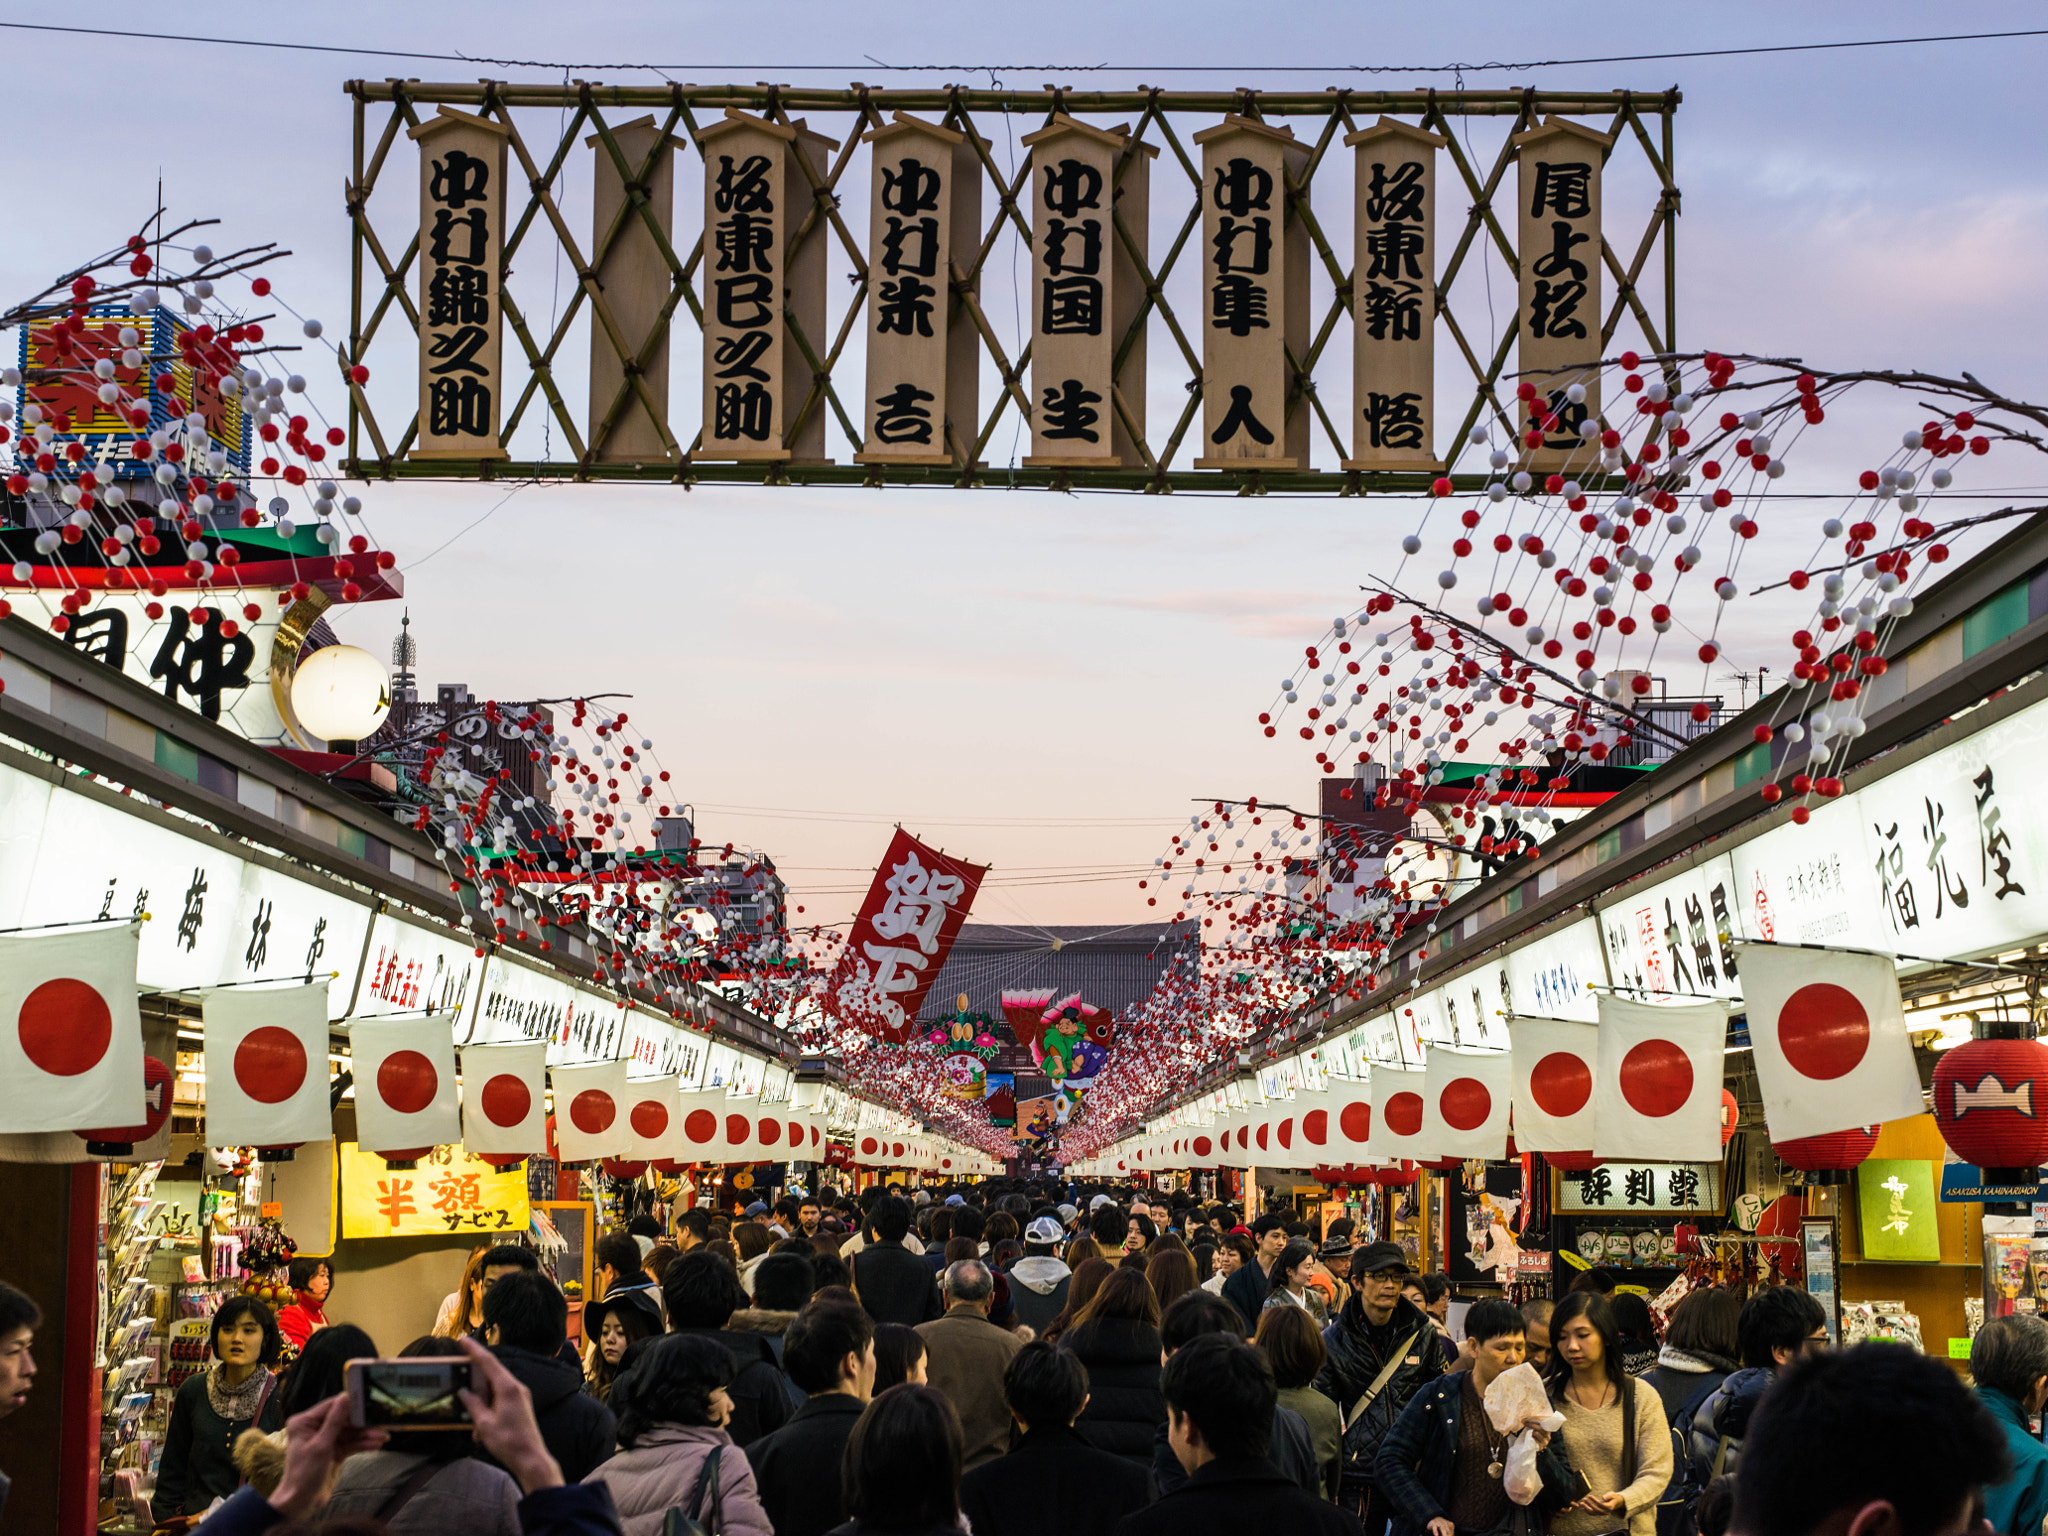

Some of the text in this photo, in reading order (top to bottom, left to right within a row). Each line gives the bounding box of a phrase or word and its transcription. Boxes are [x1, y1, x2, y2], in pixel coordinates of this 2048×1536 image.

[1875, 764, 2026, 936] 福光屋
[837, 851, 965, 1029] 賀正
[376, 1171, 486, 1227] 半額
[1580, 1168, 1699, 1207] 評判堂
[1945, 1186, 2039, 1197] ASAKUSA KAMINARIMON
[442, 1209, 513, 1231] サービス
